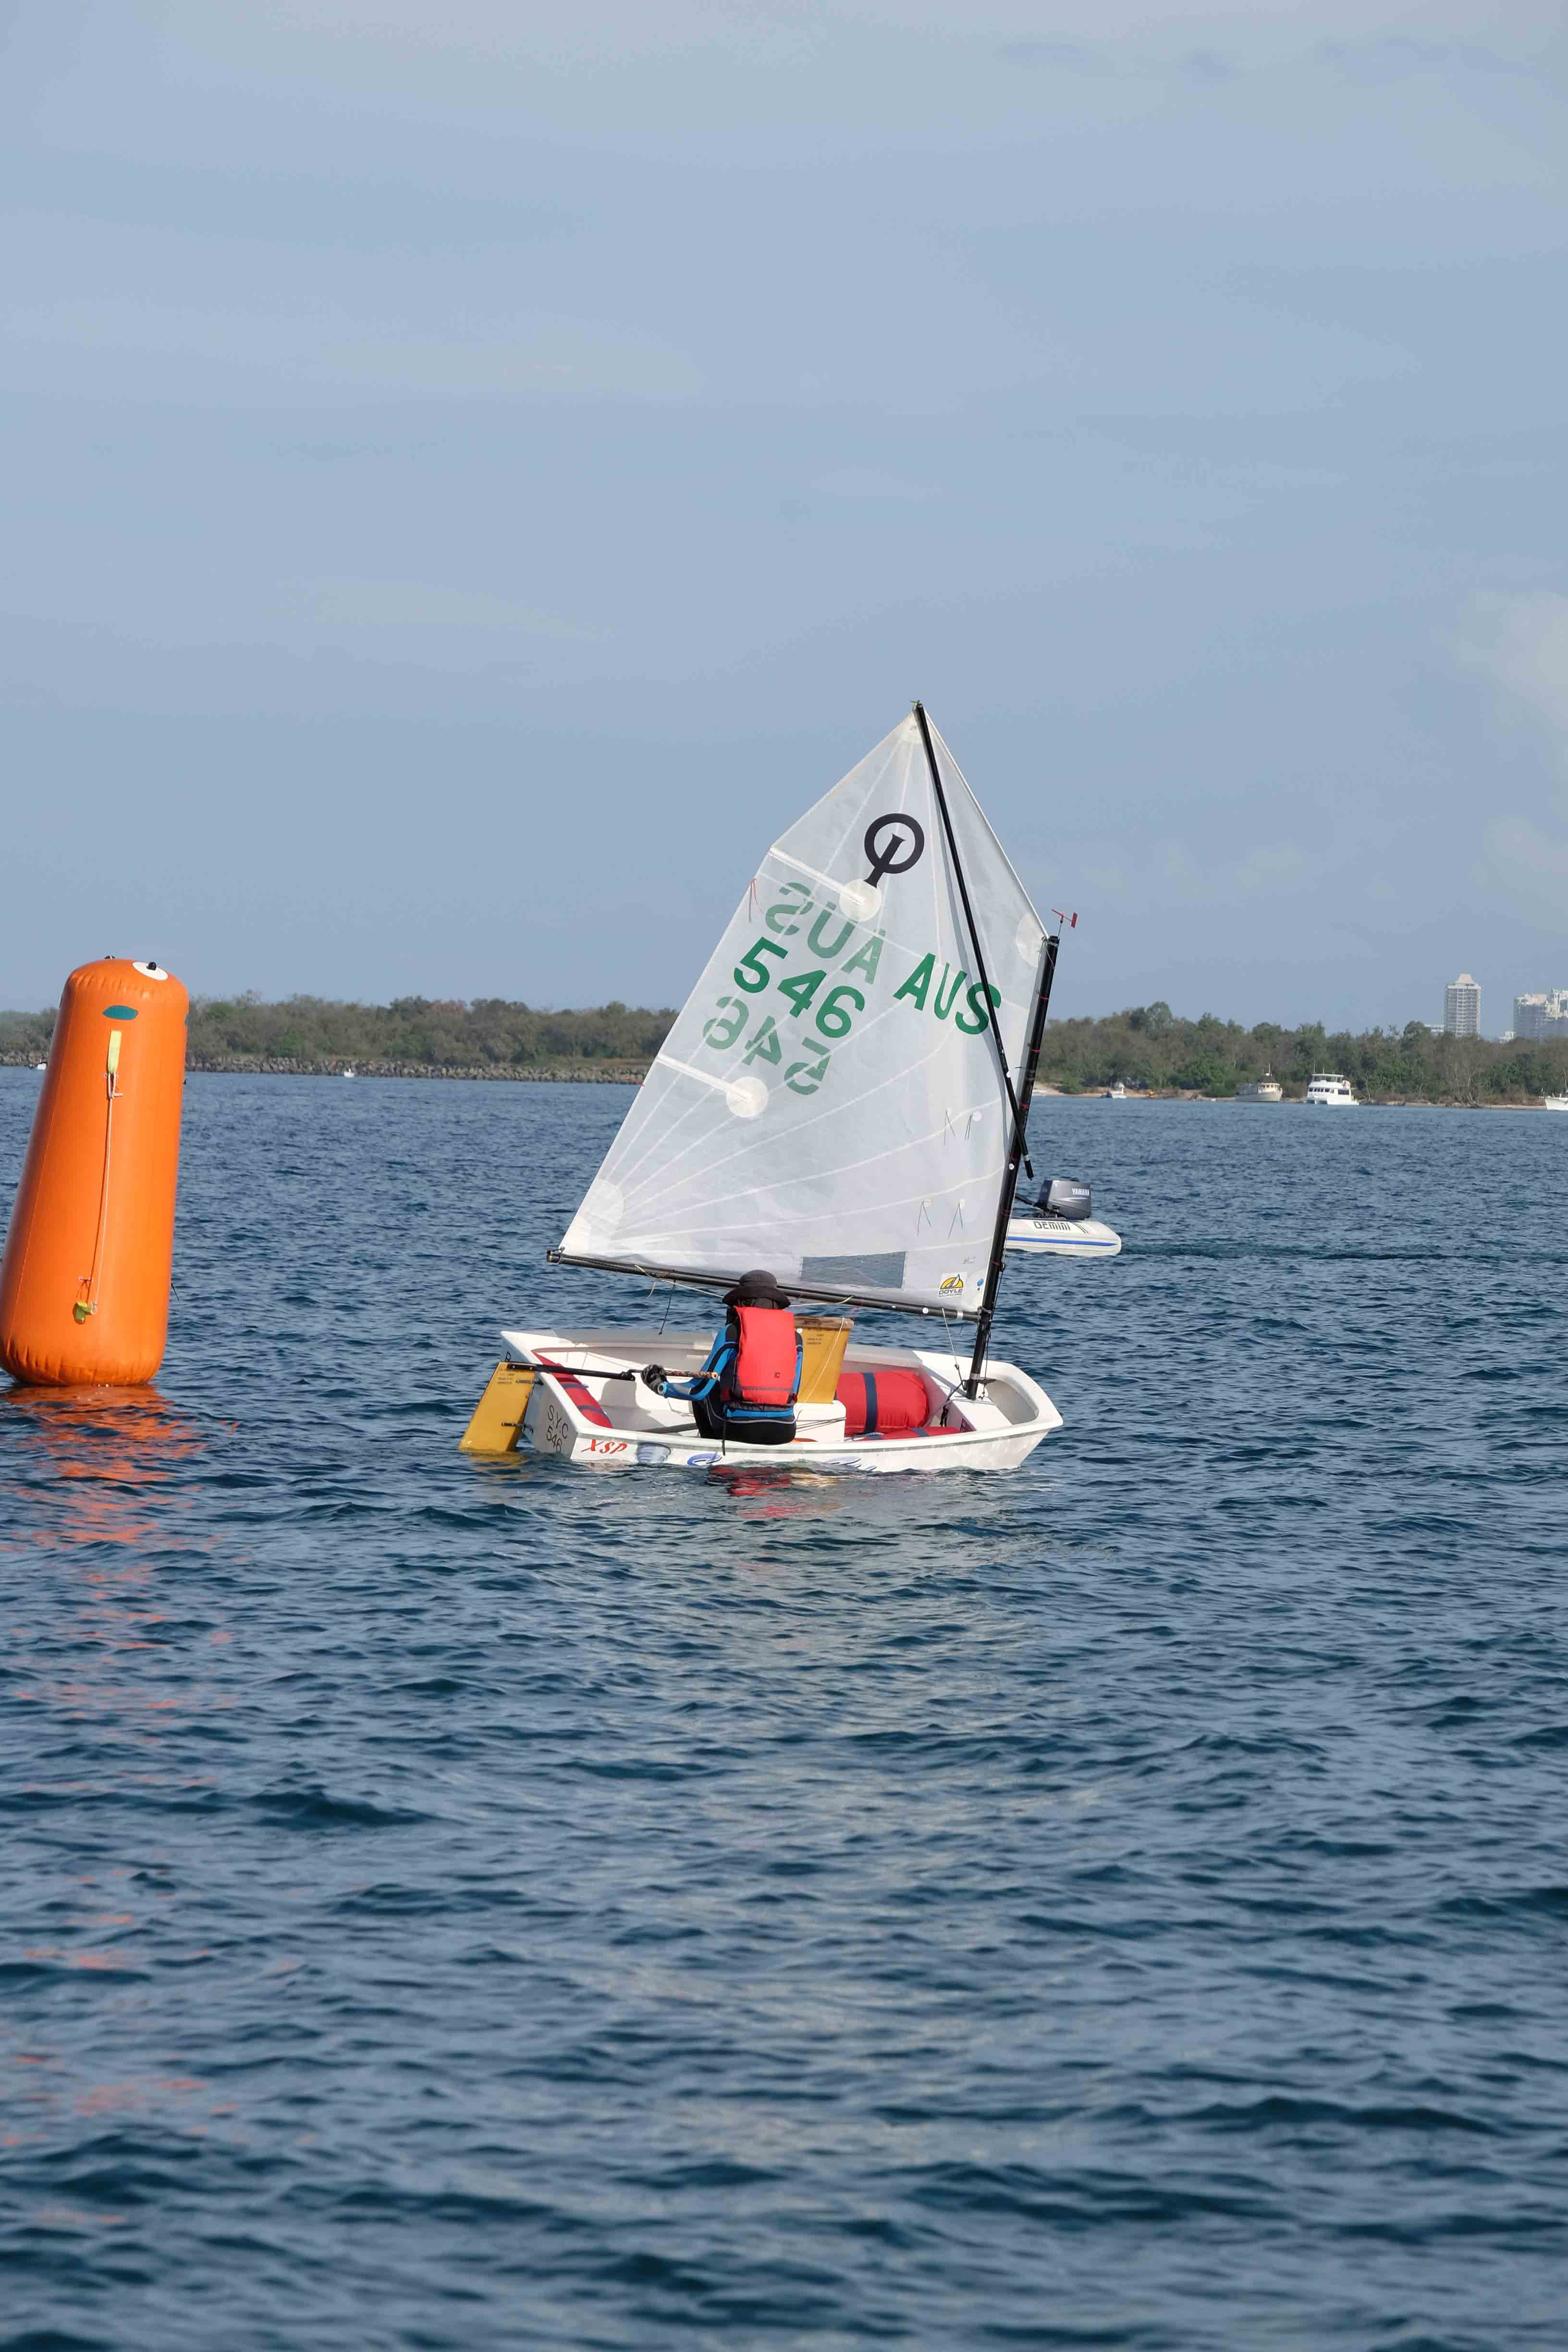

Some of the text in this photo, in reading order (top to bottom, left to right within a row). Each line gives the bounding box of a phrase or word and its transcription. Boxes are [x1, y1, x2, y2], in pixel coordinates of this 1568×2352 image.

[733, 937, 865, 1038] 546
[893, 953, 1002, 1035] AUS
[1072, 1188, 1090, 1196] YAMAHA
[1033, 1221, 1071, 1230] GEMINI
[546, 1425, 562, 1453] 546
